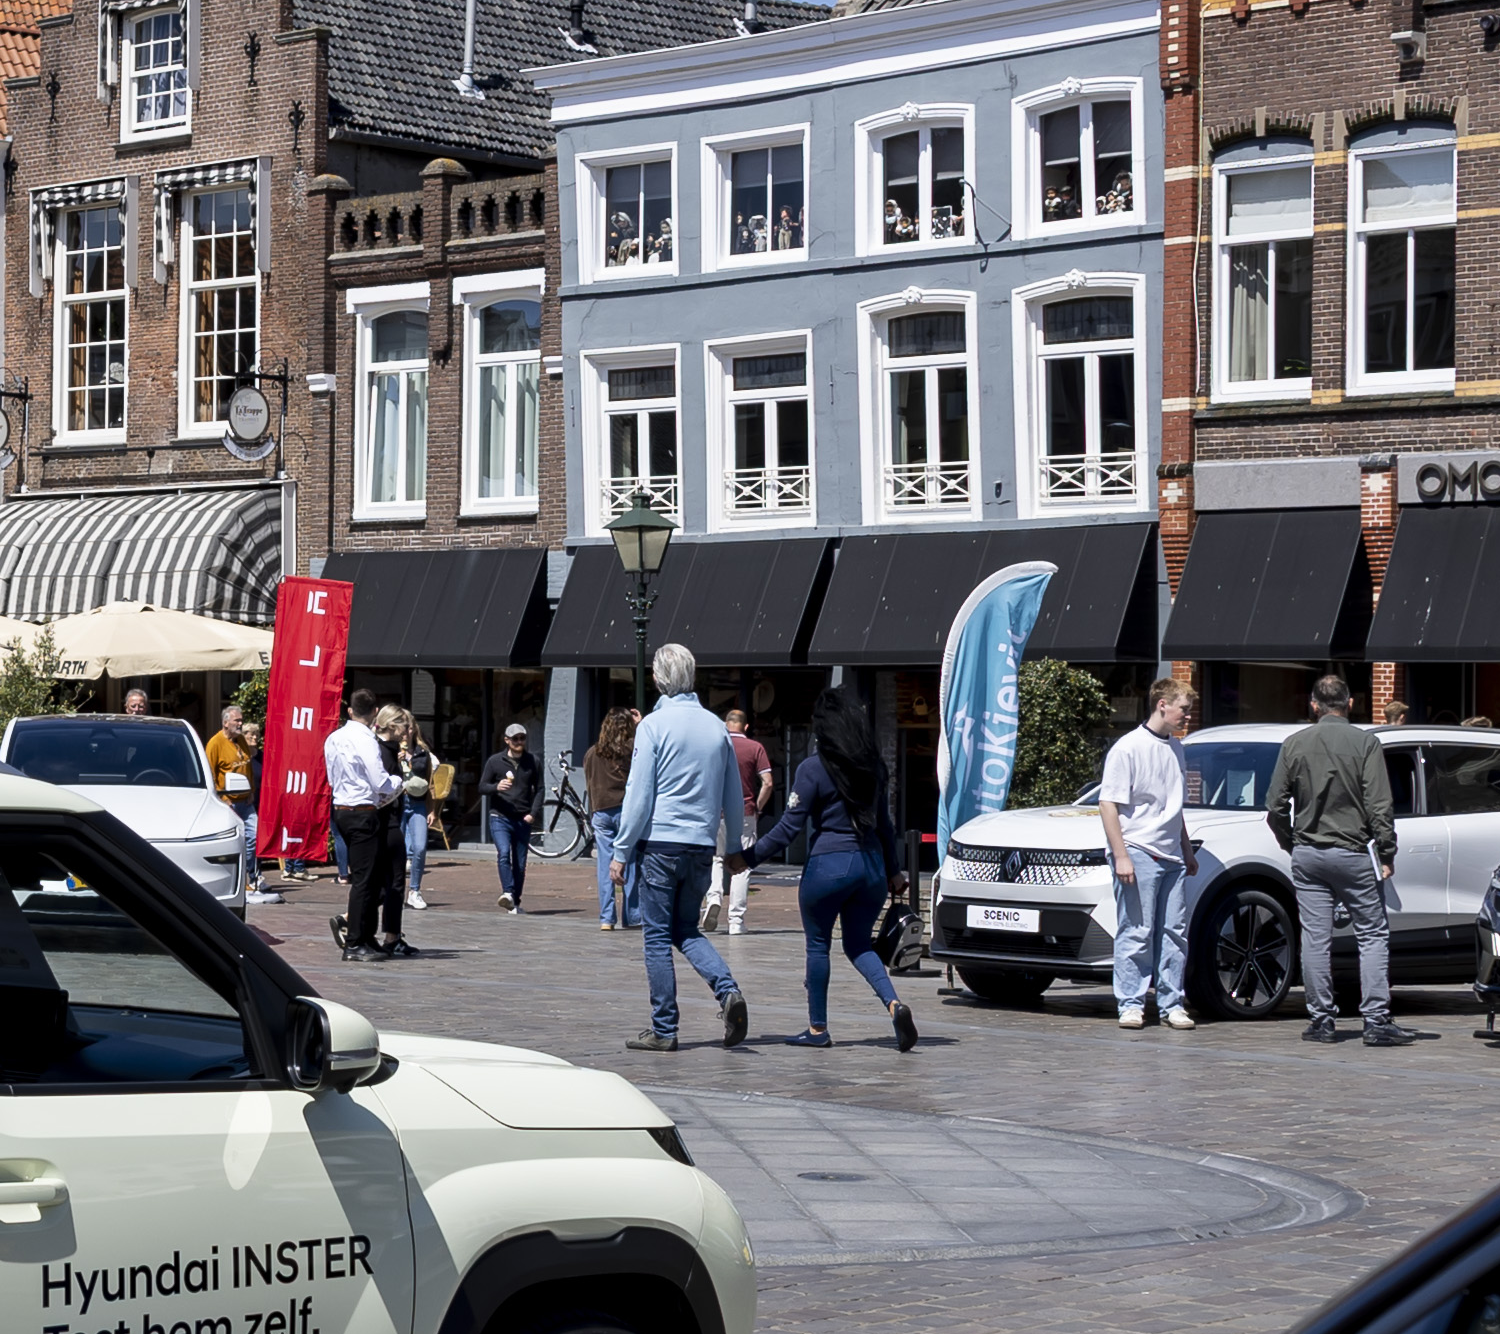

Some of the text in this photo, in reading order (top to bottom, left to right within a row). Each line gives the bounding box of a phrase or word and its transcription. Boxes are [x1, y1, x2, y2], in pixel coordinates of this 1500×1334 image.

[282, 591, 328, 851] TESLA
[984, 909, 1020, 922] SCENIC
[42, 1235, 375, 1316] Hyundai INSTER
